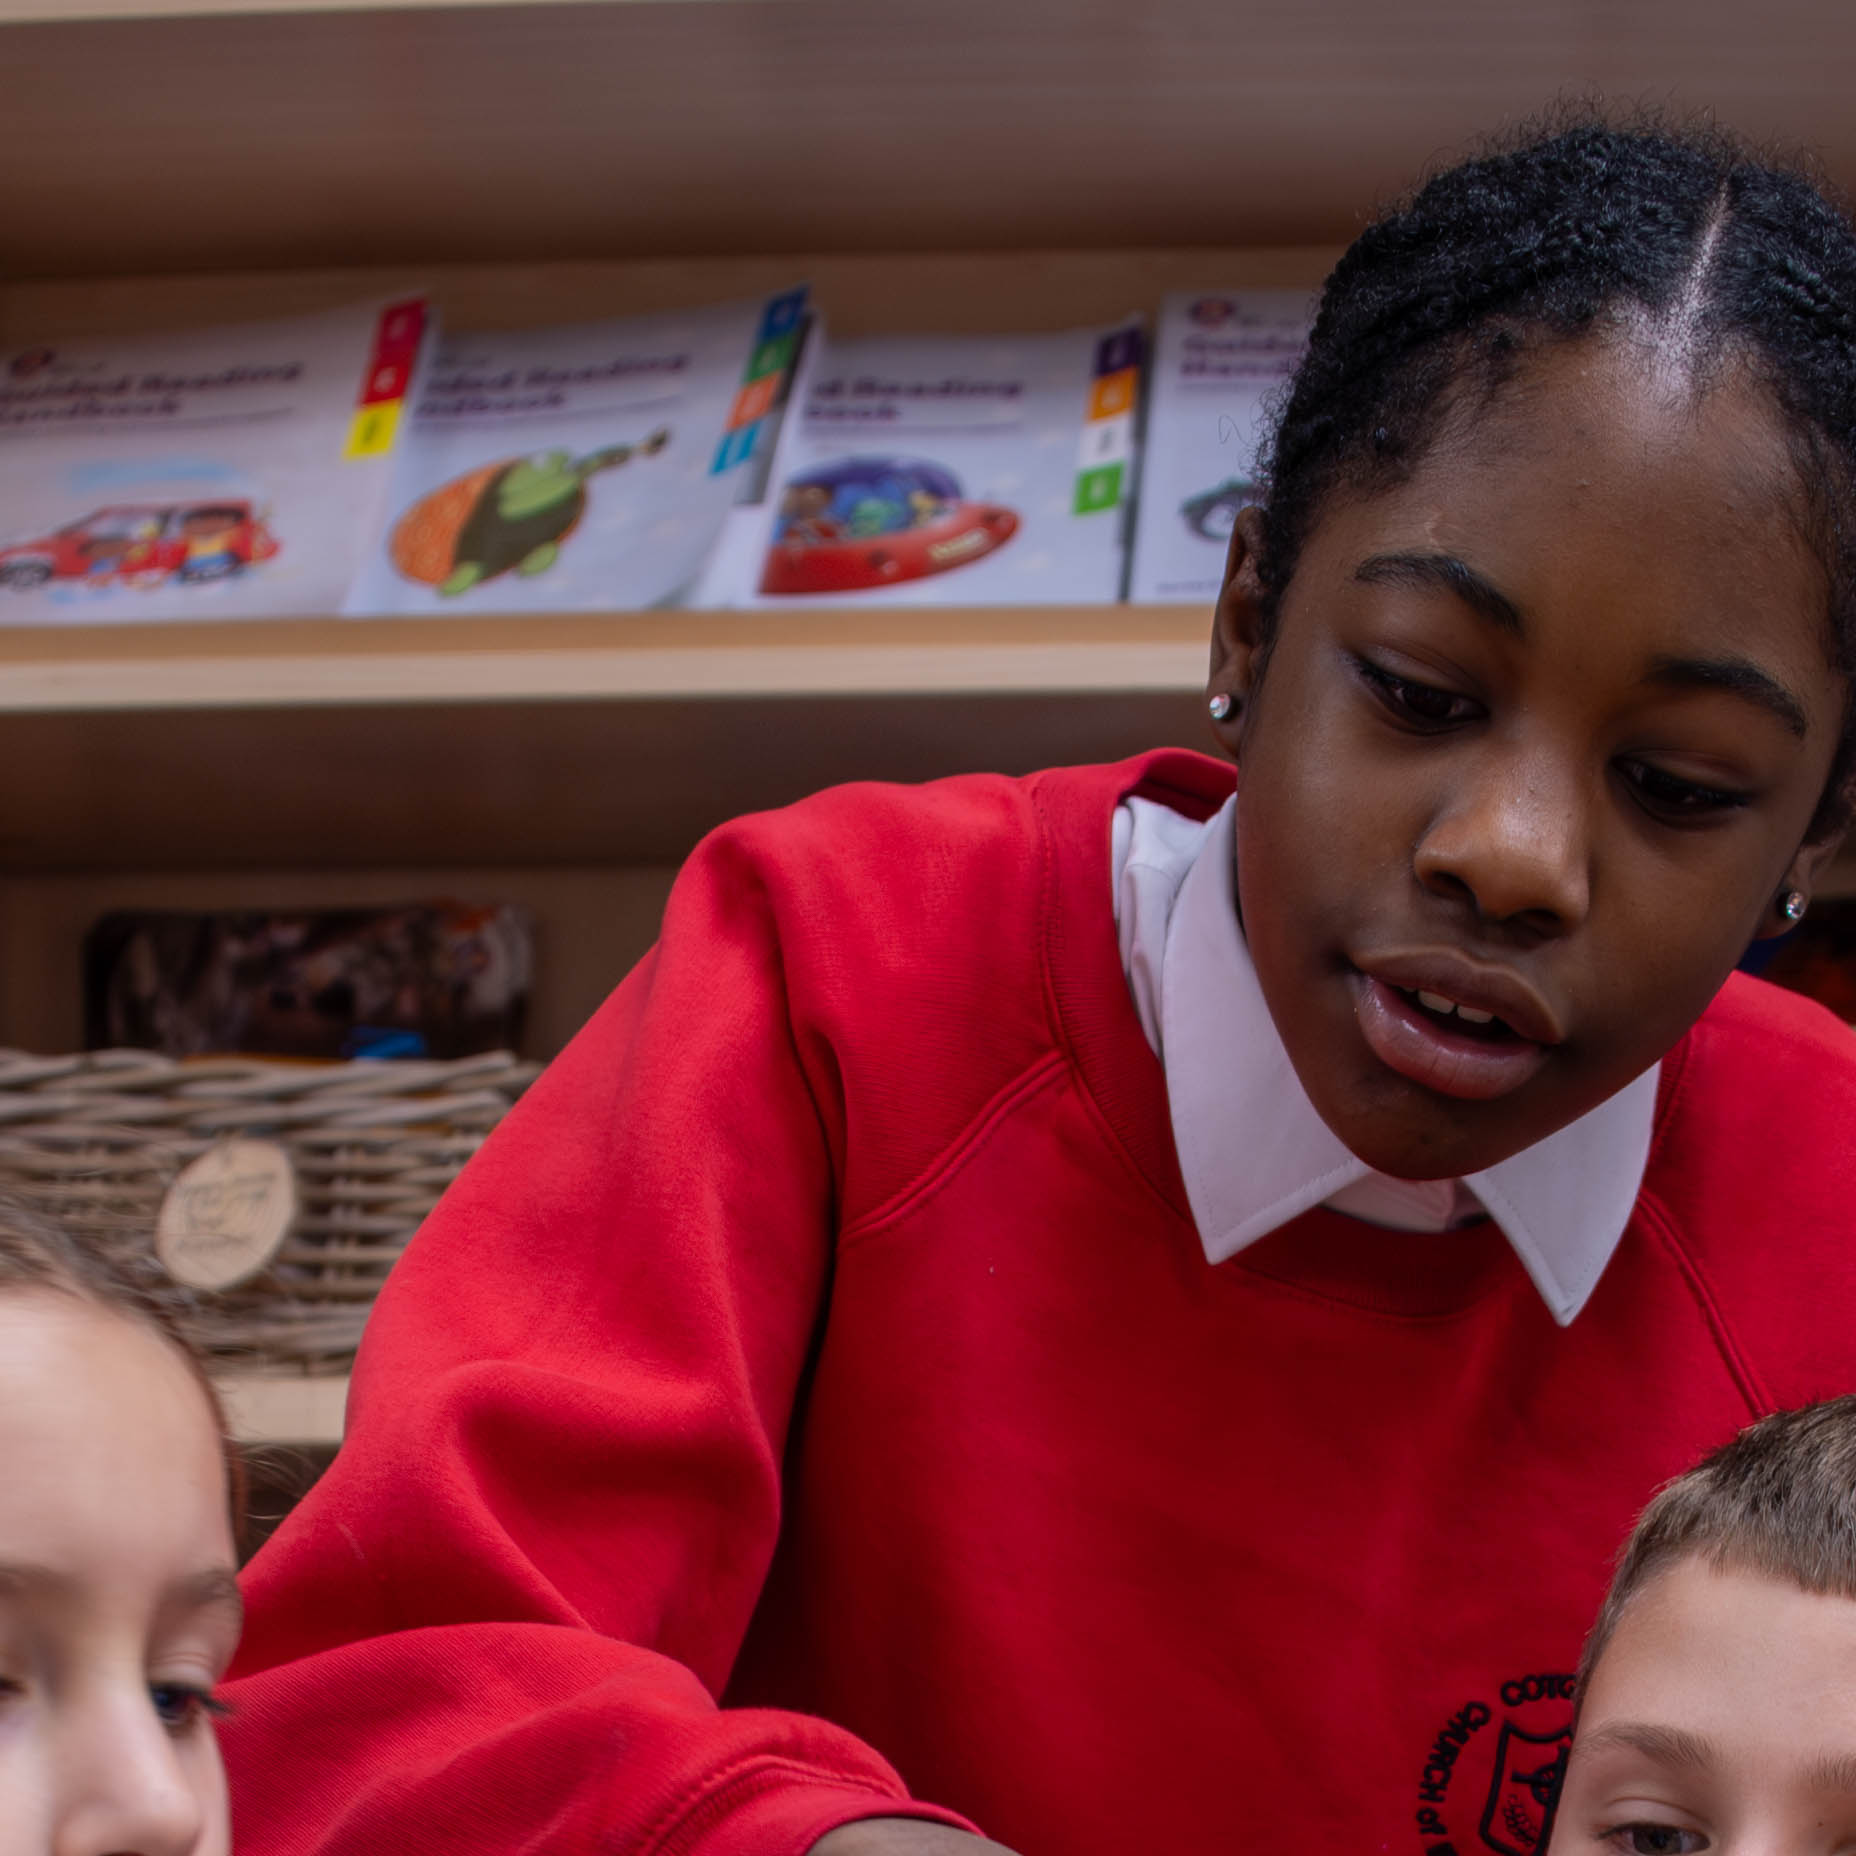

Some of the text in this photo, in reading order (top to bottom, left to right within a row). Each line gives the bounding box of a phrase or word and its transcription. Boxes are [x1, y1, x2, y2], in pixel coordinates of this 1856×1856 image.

[137, 361, 302, 394] Reading
[525, 354, 687, 391] Reading
[849, 374, 1023, 401] Reading
[1500, 1674, 1578, 1706] COTG
[1418, 1701, 1491, 1803] CHURCH
